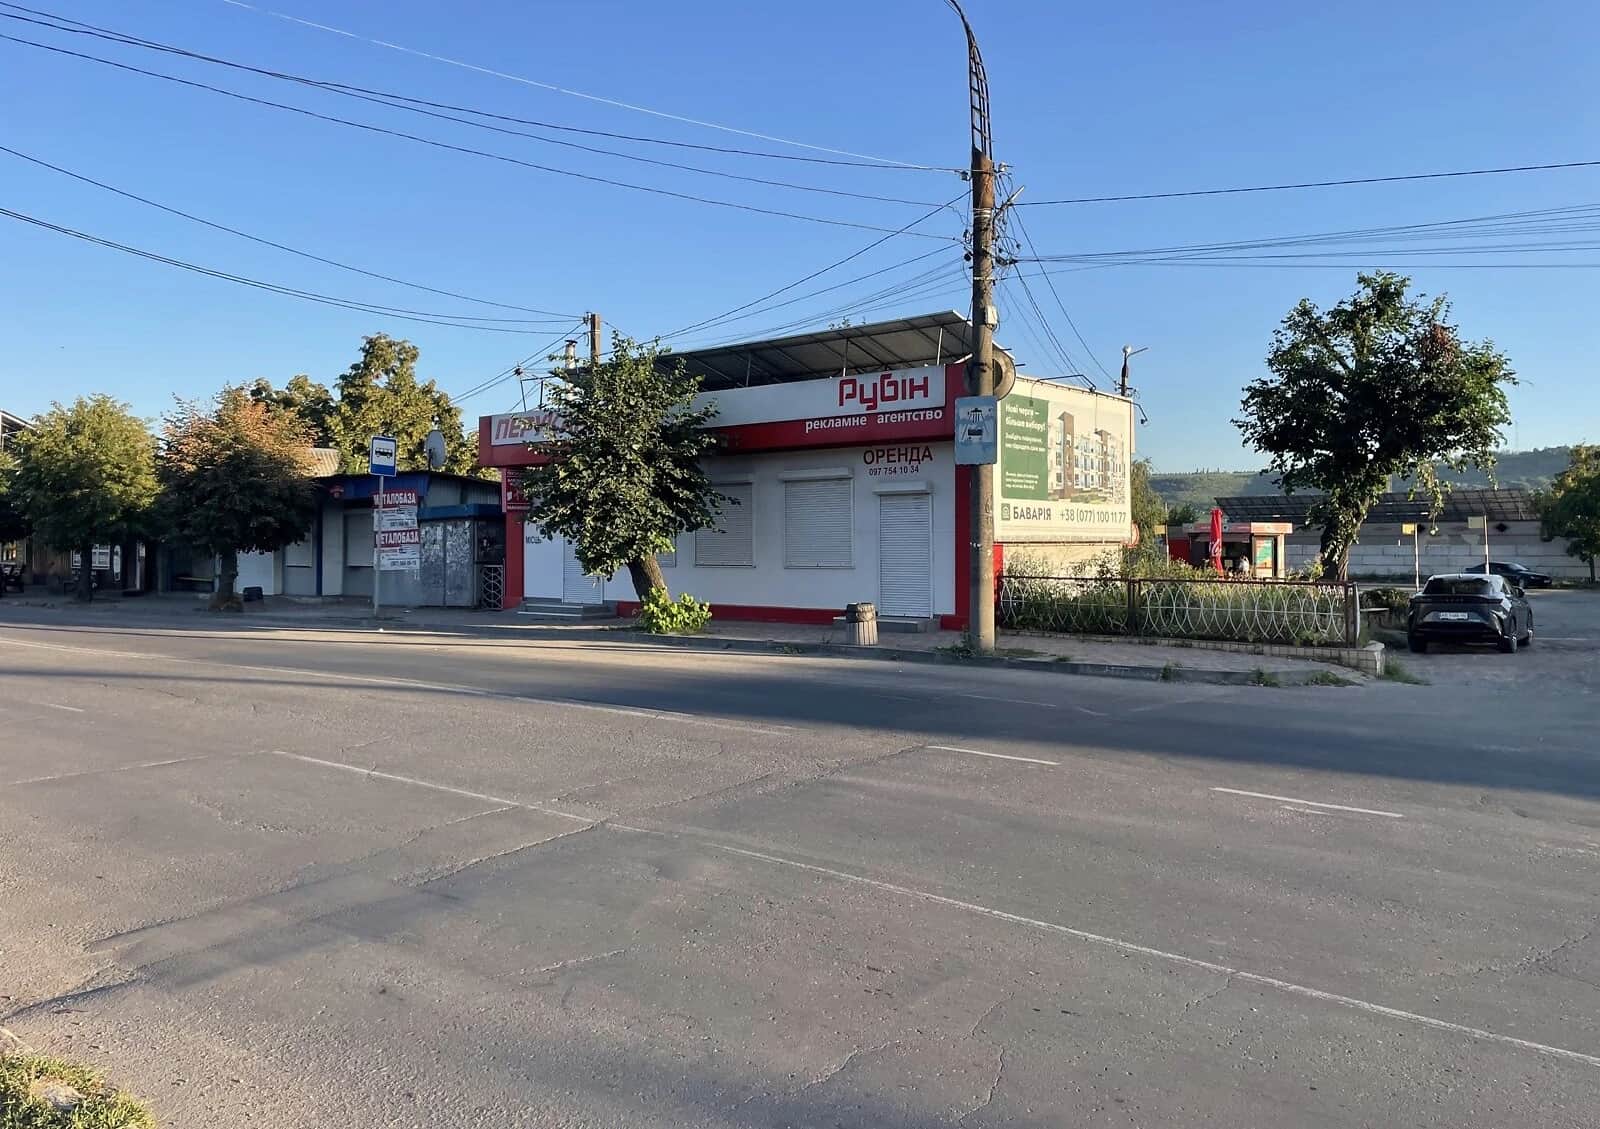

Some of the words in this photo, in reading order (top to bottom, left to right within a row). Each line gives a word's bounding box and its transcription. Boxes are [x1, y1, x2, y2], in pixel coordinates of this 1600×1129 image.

[805, 415, 868, 434] рекламне
[877, 409, 943, 424] агентство
[863, 446, 933, 465] ОРЕНДА
[869, 467, 881, 476] 097
[884, 466, 897, 475] 754
[900, 465, 908, 474] 10
[911, 464, 919, 473] 34
[373, 492, 416, 505] МТАЛОБАЗА
[1013, 506, 1051, 520] БАВАРІЯ
[1060, 508, 1075, 521] +38
[1077, 508, 1096, 522] (077)
[1097, 511, 1110, 522] 100
[1111, 512, 1117, 522] 11
[1118, 512, 1127, 522] 77
